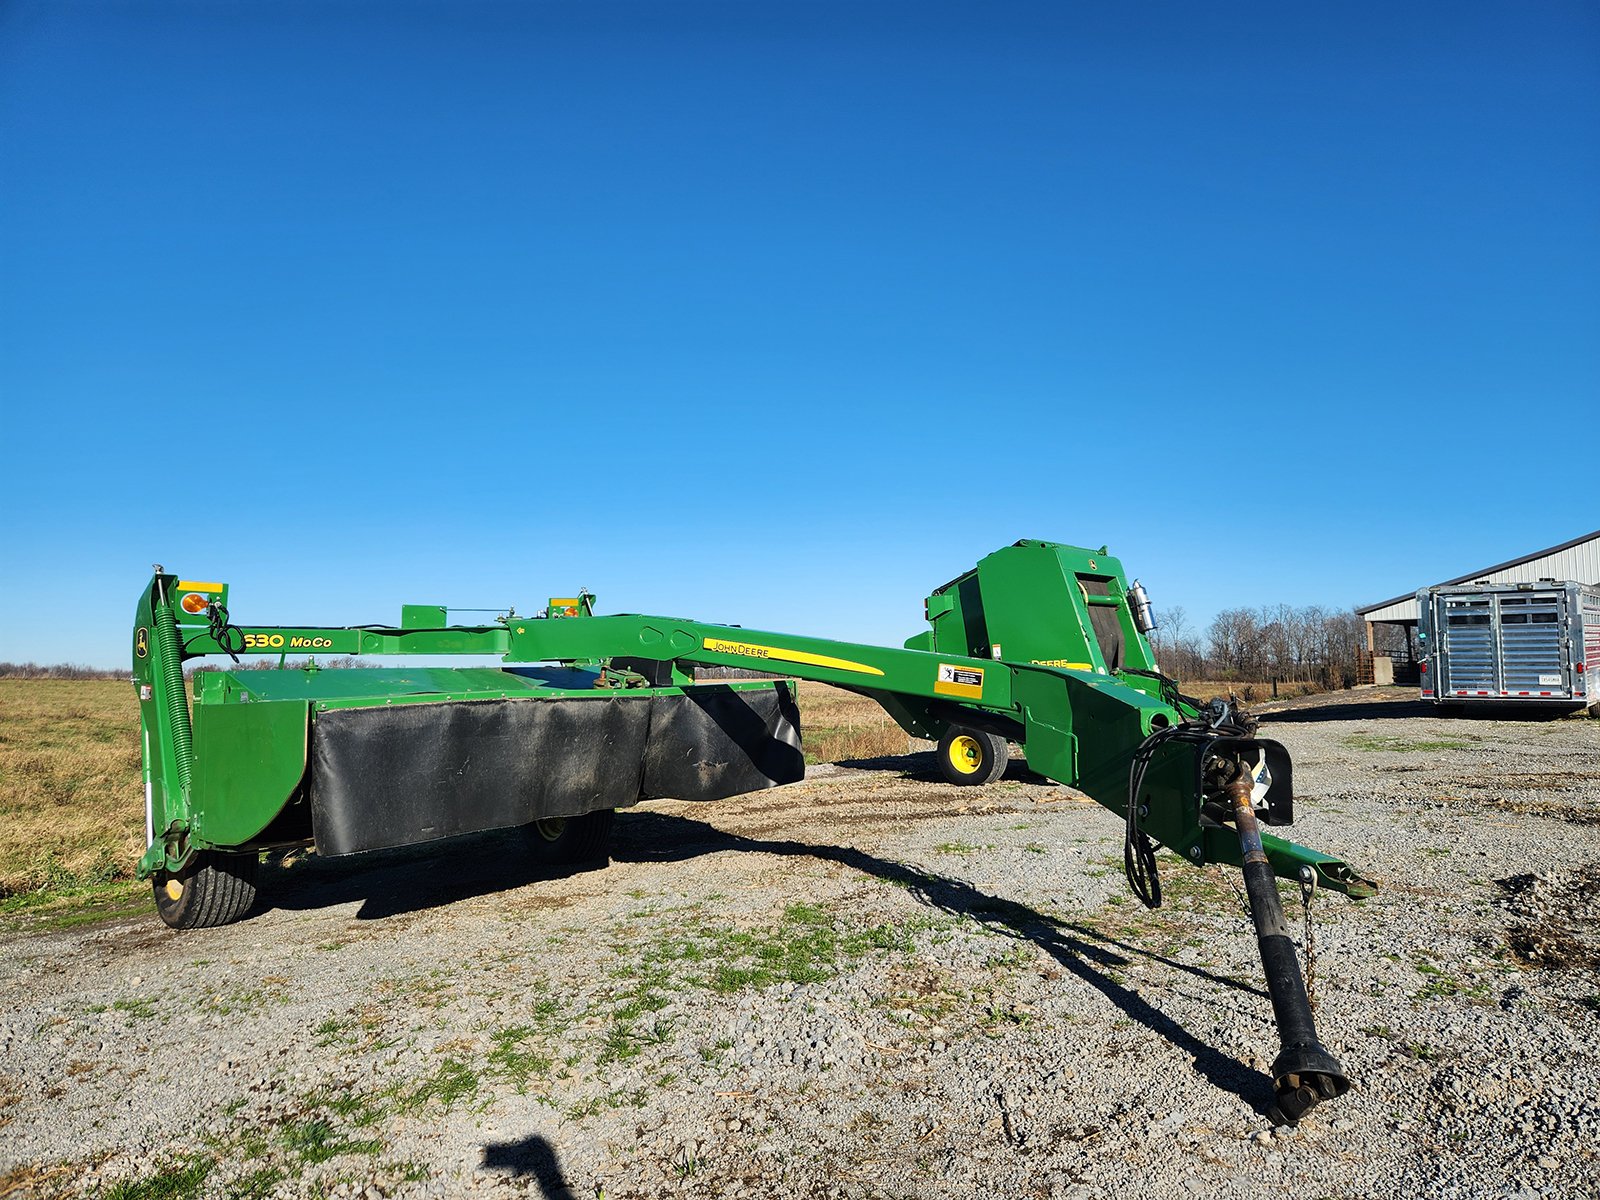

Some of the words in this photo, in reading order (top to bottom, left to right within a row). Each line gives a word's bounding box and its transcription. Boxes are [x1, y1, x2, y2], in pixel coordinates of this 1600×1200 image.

[290, 637, 332, 648] MoCo
[713, 642, 737, 653] JOHN
[738, 644, 769, 657] DEERE
